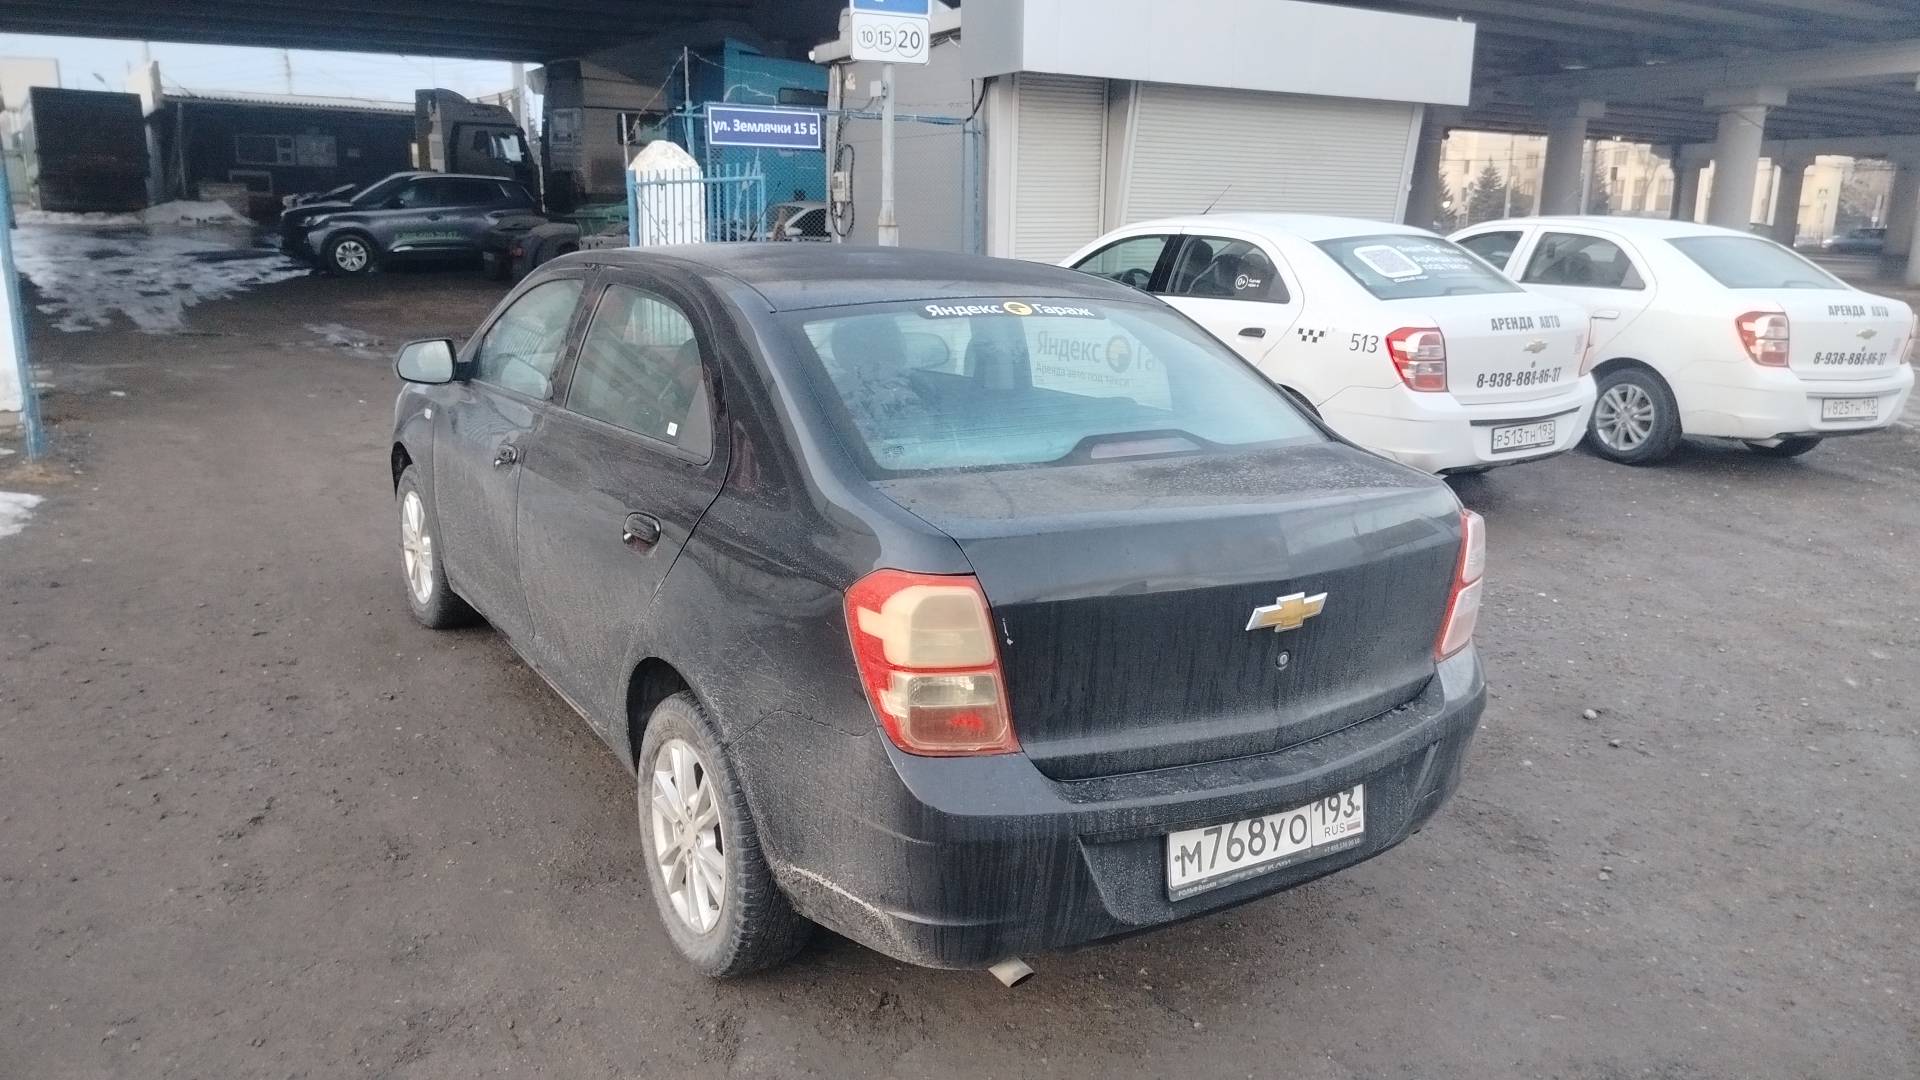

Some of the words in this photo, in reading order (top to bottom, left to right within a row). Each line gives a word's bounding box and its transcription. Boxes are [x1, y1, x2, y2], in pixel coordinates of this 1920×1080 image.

[862, 31, 873, 43] 10
[878, 30, 892, 45] 15
[898, 30, 920, 49] 20
[713, 120, 730, 133] ул.
[733, 119, 791, 134] Землячки
[794, 122, 807, 135] 15
[809, 124, 818, 135] Б
[925, 304, 1004, 317] Яндекс
[1031, 303, 1095, 317] Гараж
[1828, 305, 1865, 317] АРЕНДА
[1491, 317, 1534, 331] АРЕНДА
[1539, 315, 1561, 328] АВТО
[1037, 330, 1102, 363] Яндекс
[1349, 333, 1379, 354] 513
[1314, 791, 1355, 826] 193
[1324, 822, 1345, 838] RUS
